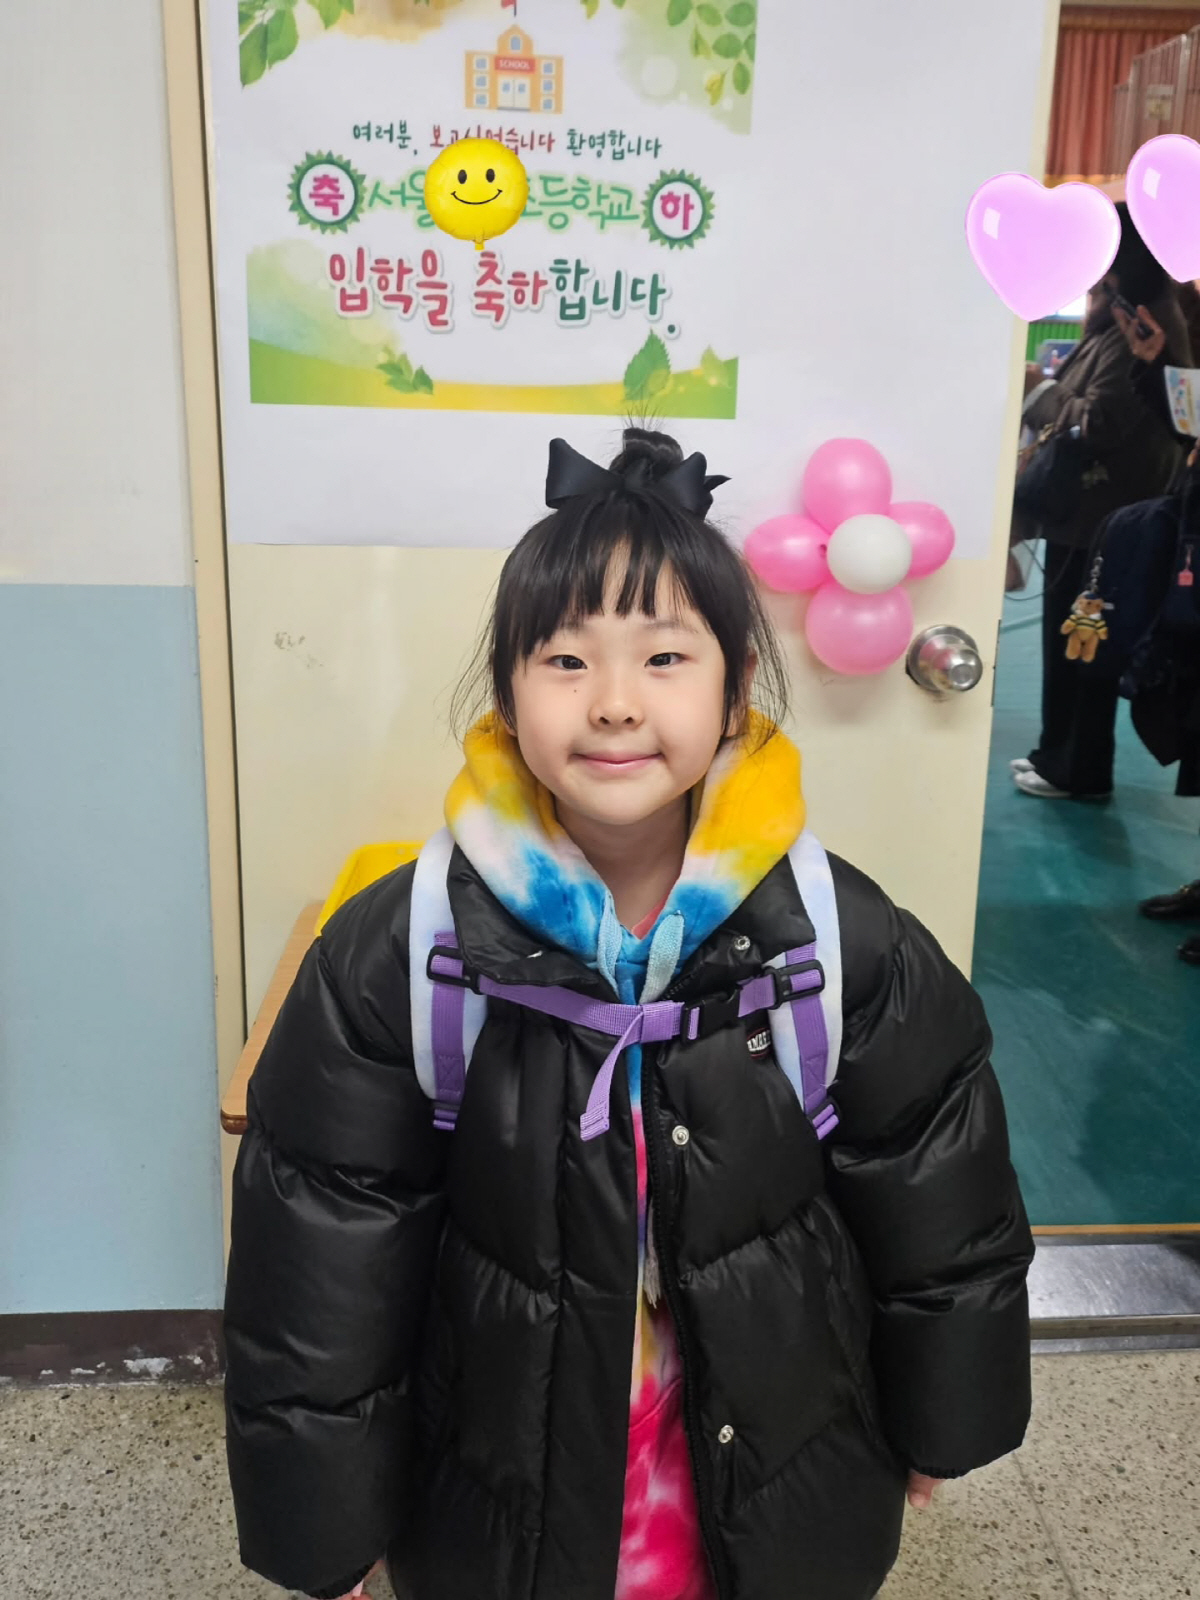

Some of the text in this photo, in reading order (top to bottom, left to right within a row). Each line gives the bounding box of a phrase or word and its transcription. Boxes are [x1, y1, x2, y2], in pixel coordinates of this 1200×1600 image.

[499, 59, 531, 70] SCHOOL
[353, 120, 418, 156] 여러분,
[566, 129, 663, 160] 환영합니다
[308, 175, 345, 217] 축
[659, 192, 695, 230] 하
[329, 247, 675, 334] 입학을 축하합니다.
